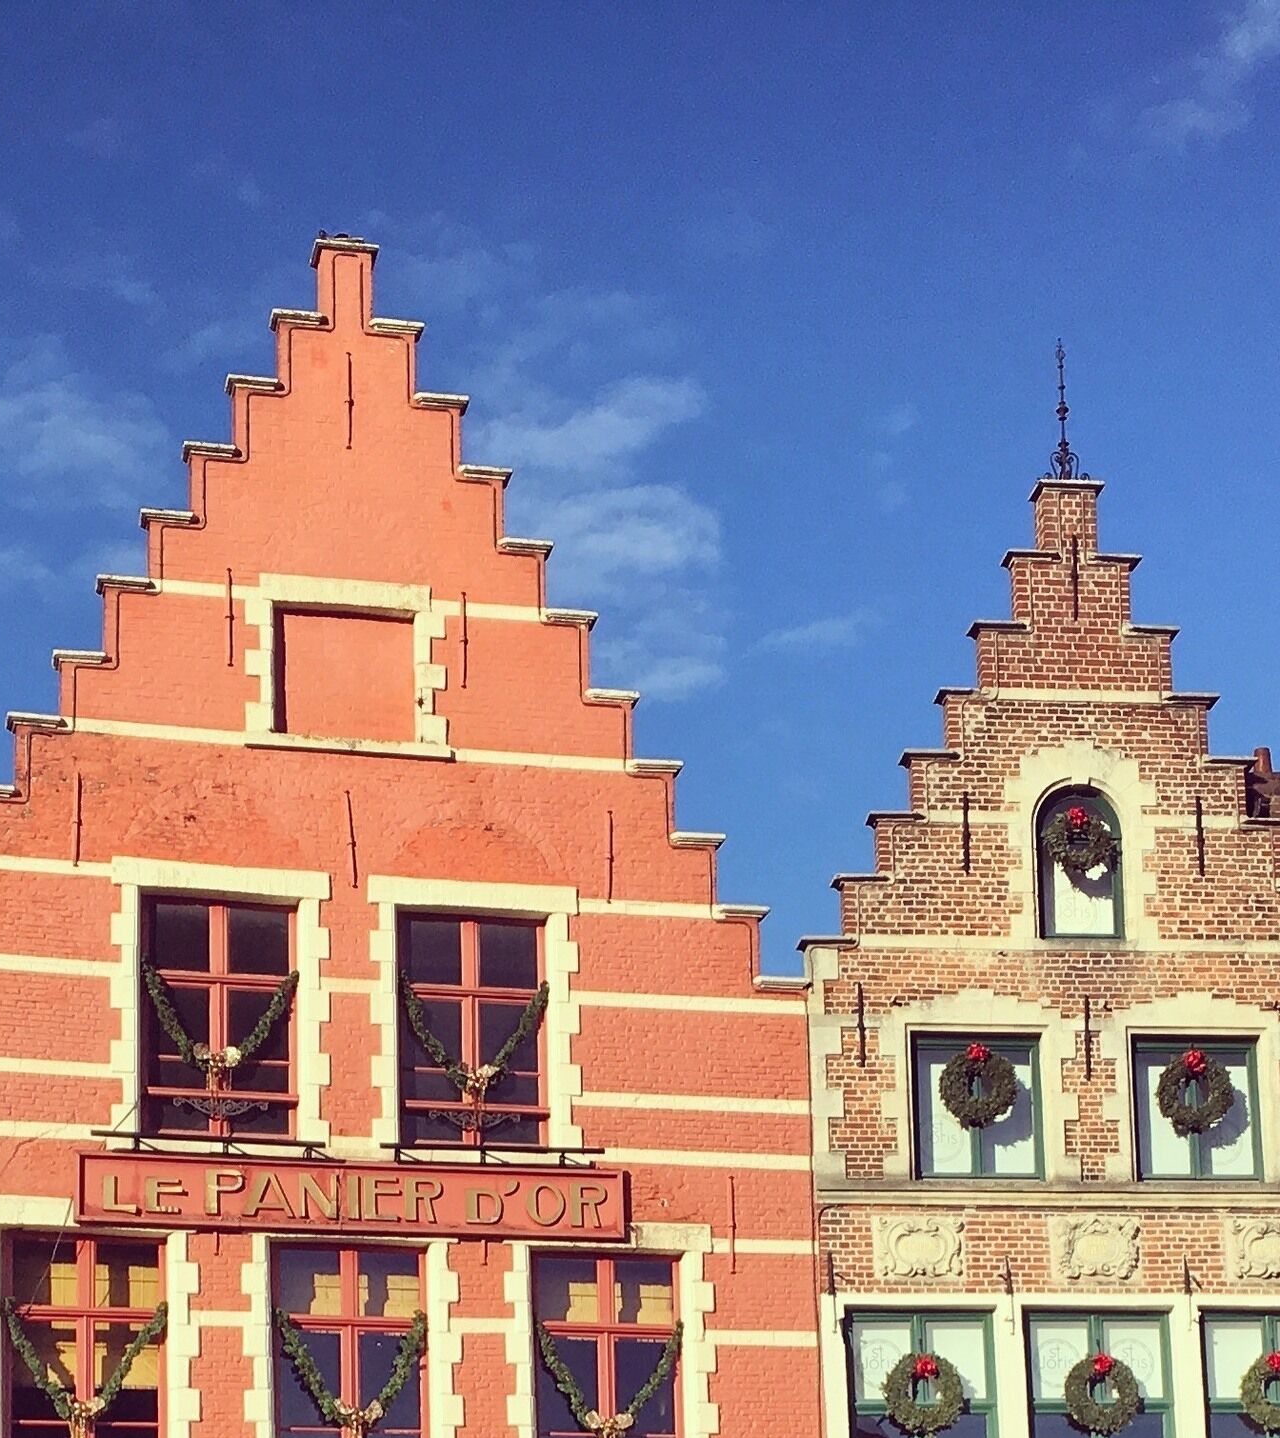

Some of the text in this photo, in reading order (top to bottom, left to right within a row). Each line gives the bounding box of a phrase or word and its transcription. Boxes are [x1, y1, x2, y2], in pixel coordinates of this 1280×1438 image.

[102, 1168, 608, 1229] LE PANIER D'OR
